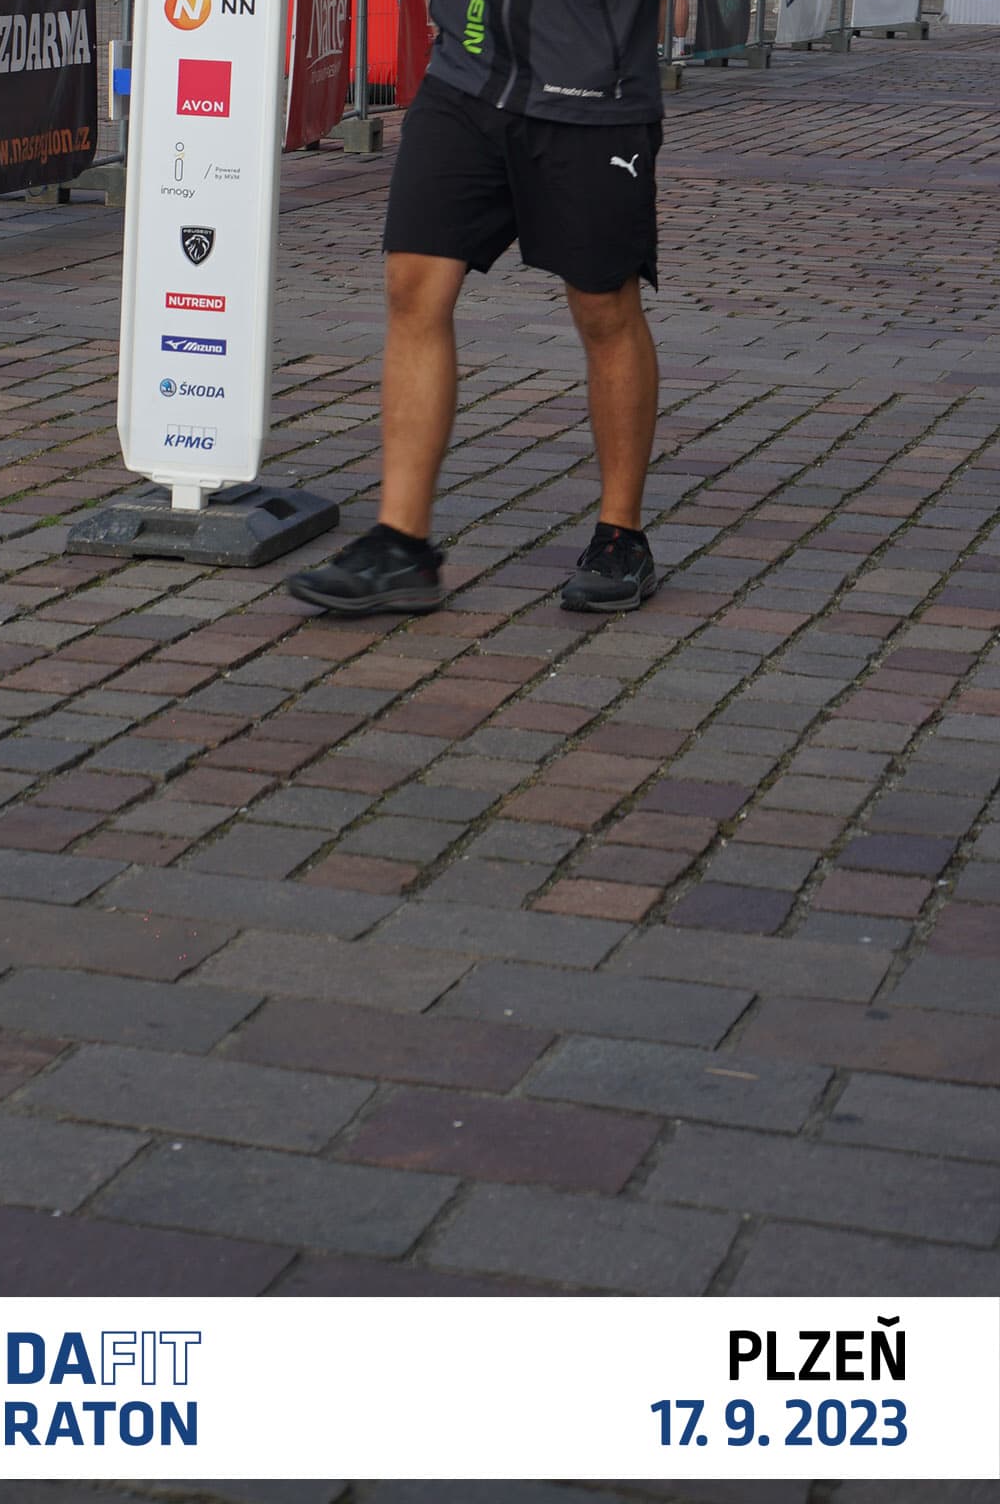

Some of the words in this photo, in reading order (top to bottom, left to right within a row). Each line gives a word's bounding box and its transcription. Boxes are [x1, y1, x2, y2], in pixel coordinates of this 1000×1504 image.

[181, 100, 224, 113] AVON
[161, 185, 196, 198] innogy
[168, 295, 224, 310] NUTREND
[178, 382, 225, 399] ŠKODA
[164, 433, 215, 450] KPMG
